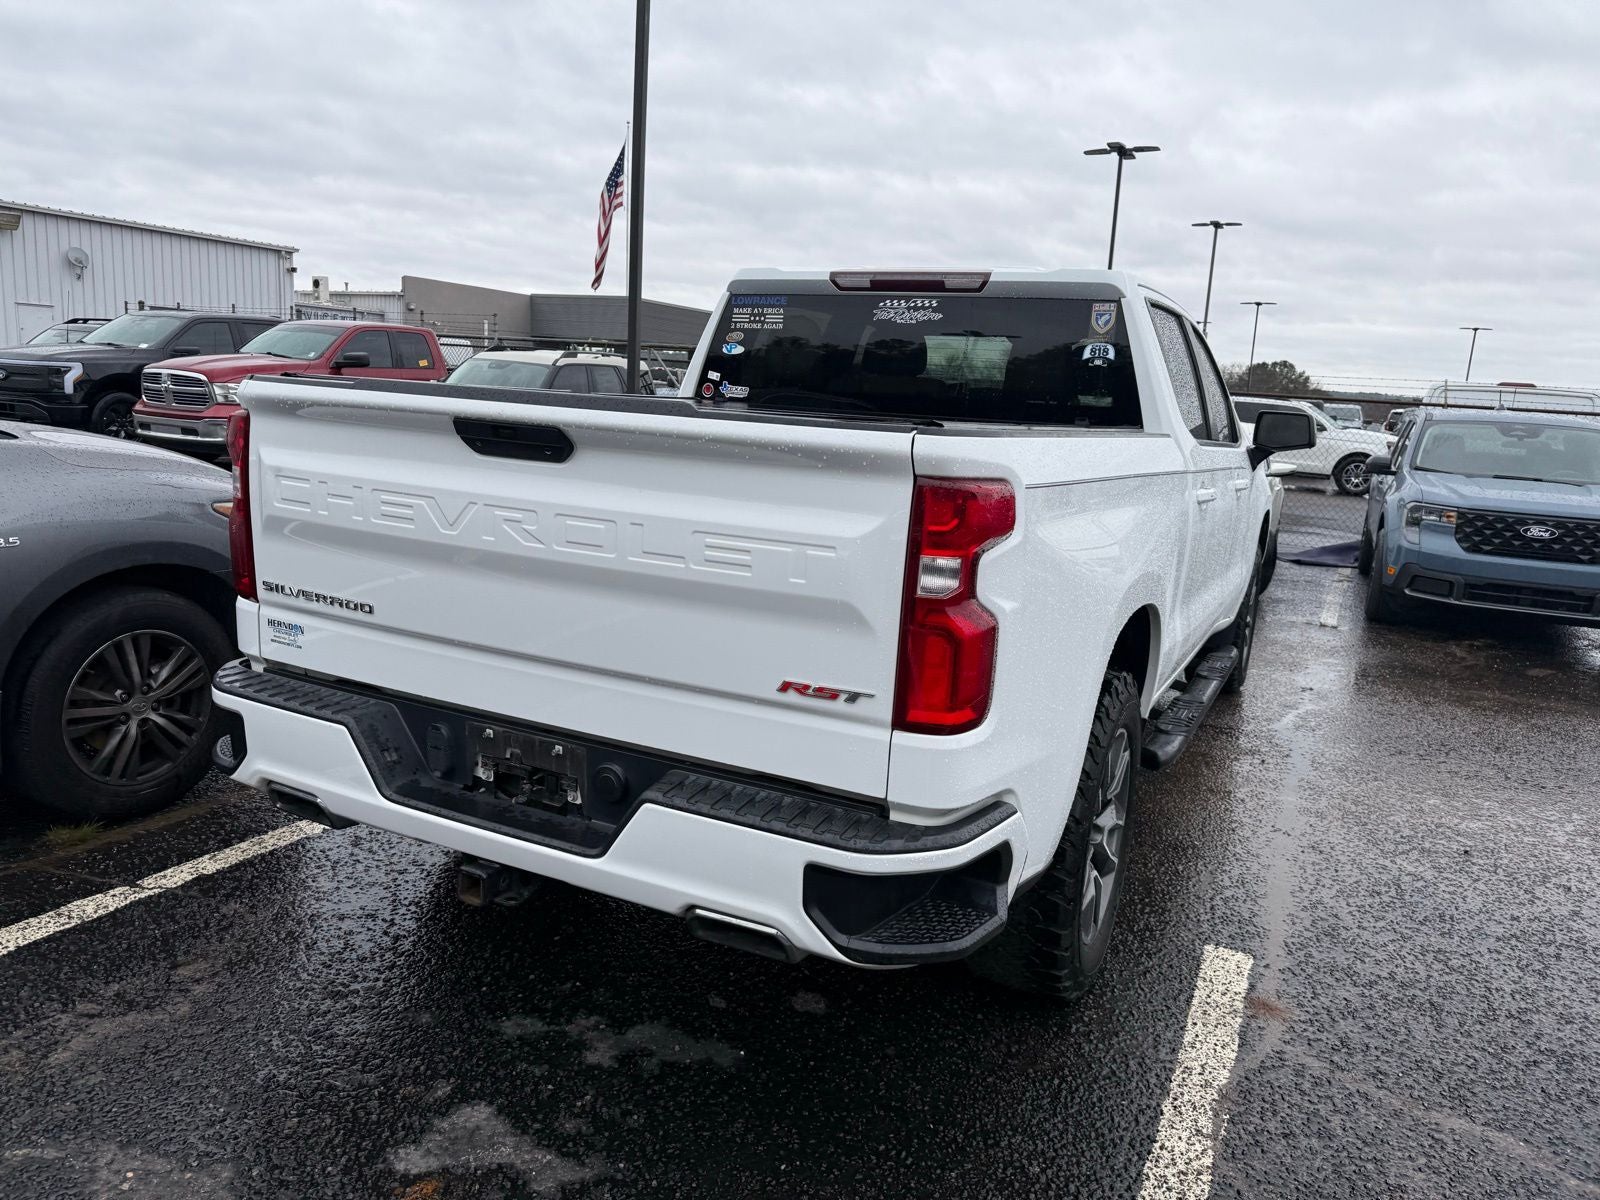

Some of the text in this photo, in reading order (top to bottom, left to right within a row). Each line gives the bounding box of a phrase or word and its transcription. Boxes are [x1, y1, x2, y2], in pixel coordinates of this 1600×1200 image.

[732, 296, 788, 305] LOWRANCE
[1089, 347, 1110, 357] 818
[274, 474, 837, 584] CHEVROLET
[262, 580, 375, 614] SILVERADO
[267, 618, 305, 635] HERNDON
[776, 680, 876, 704] RST
